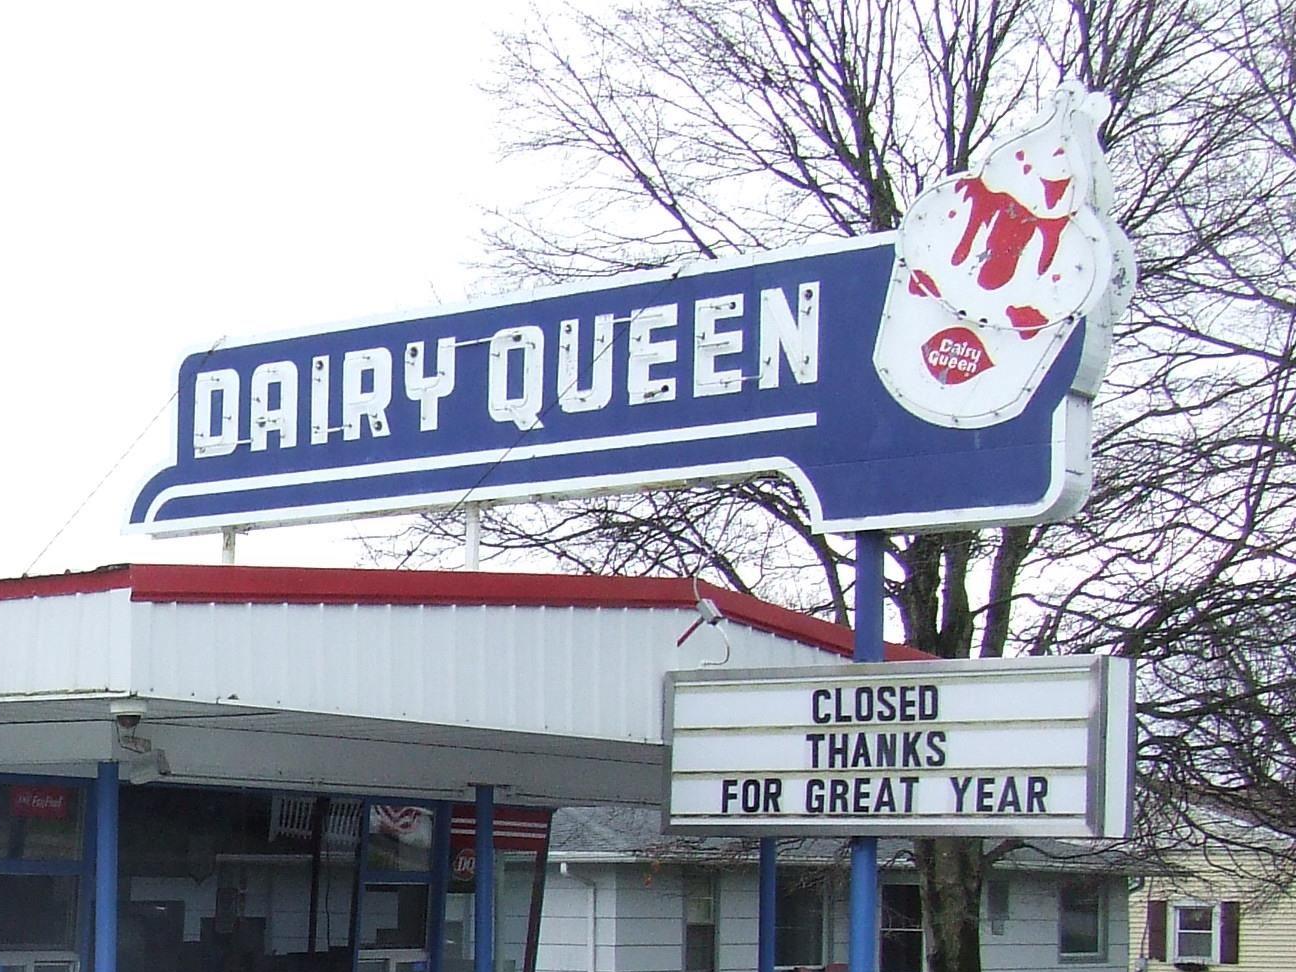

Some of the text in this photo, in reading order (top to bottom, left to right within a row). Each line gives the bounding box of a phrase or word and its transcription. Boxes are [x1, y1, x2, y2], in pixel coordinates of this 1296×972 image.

[193, 281, 820, 458] DAIRY QUEEN
[927, 350, 977, 373] Queen
[939, 338, 981, 363] Dairy
[812, 684, 939, 724] CLOSED
[806, 731, 947, 769] THANKS
[721, 776, 1049, 814] FOR GREAT YEAR
